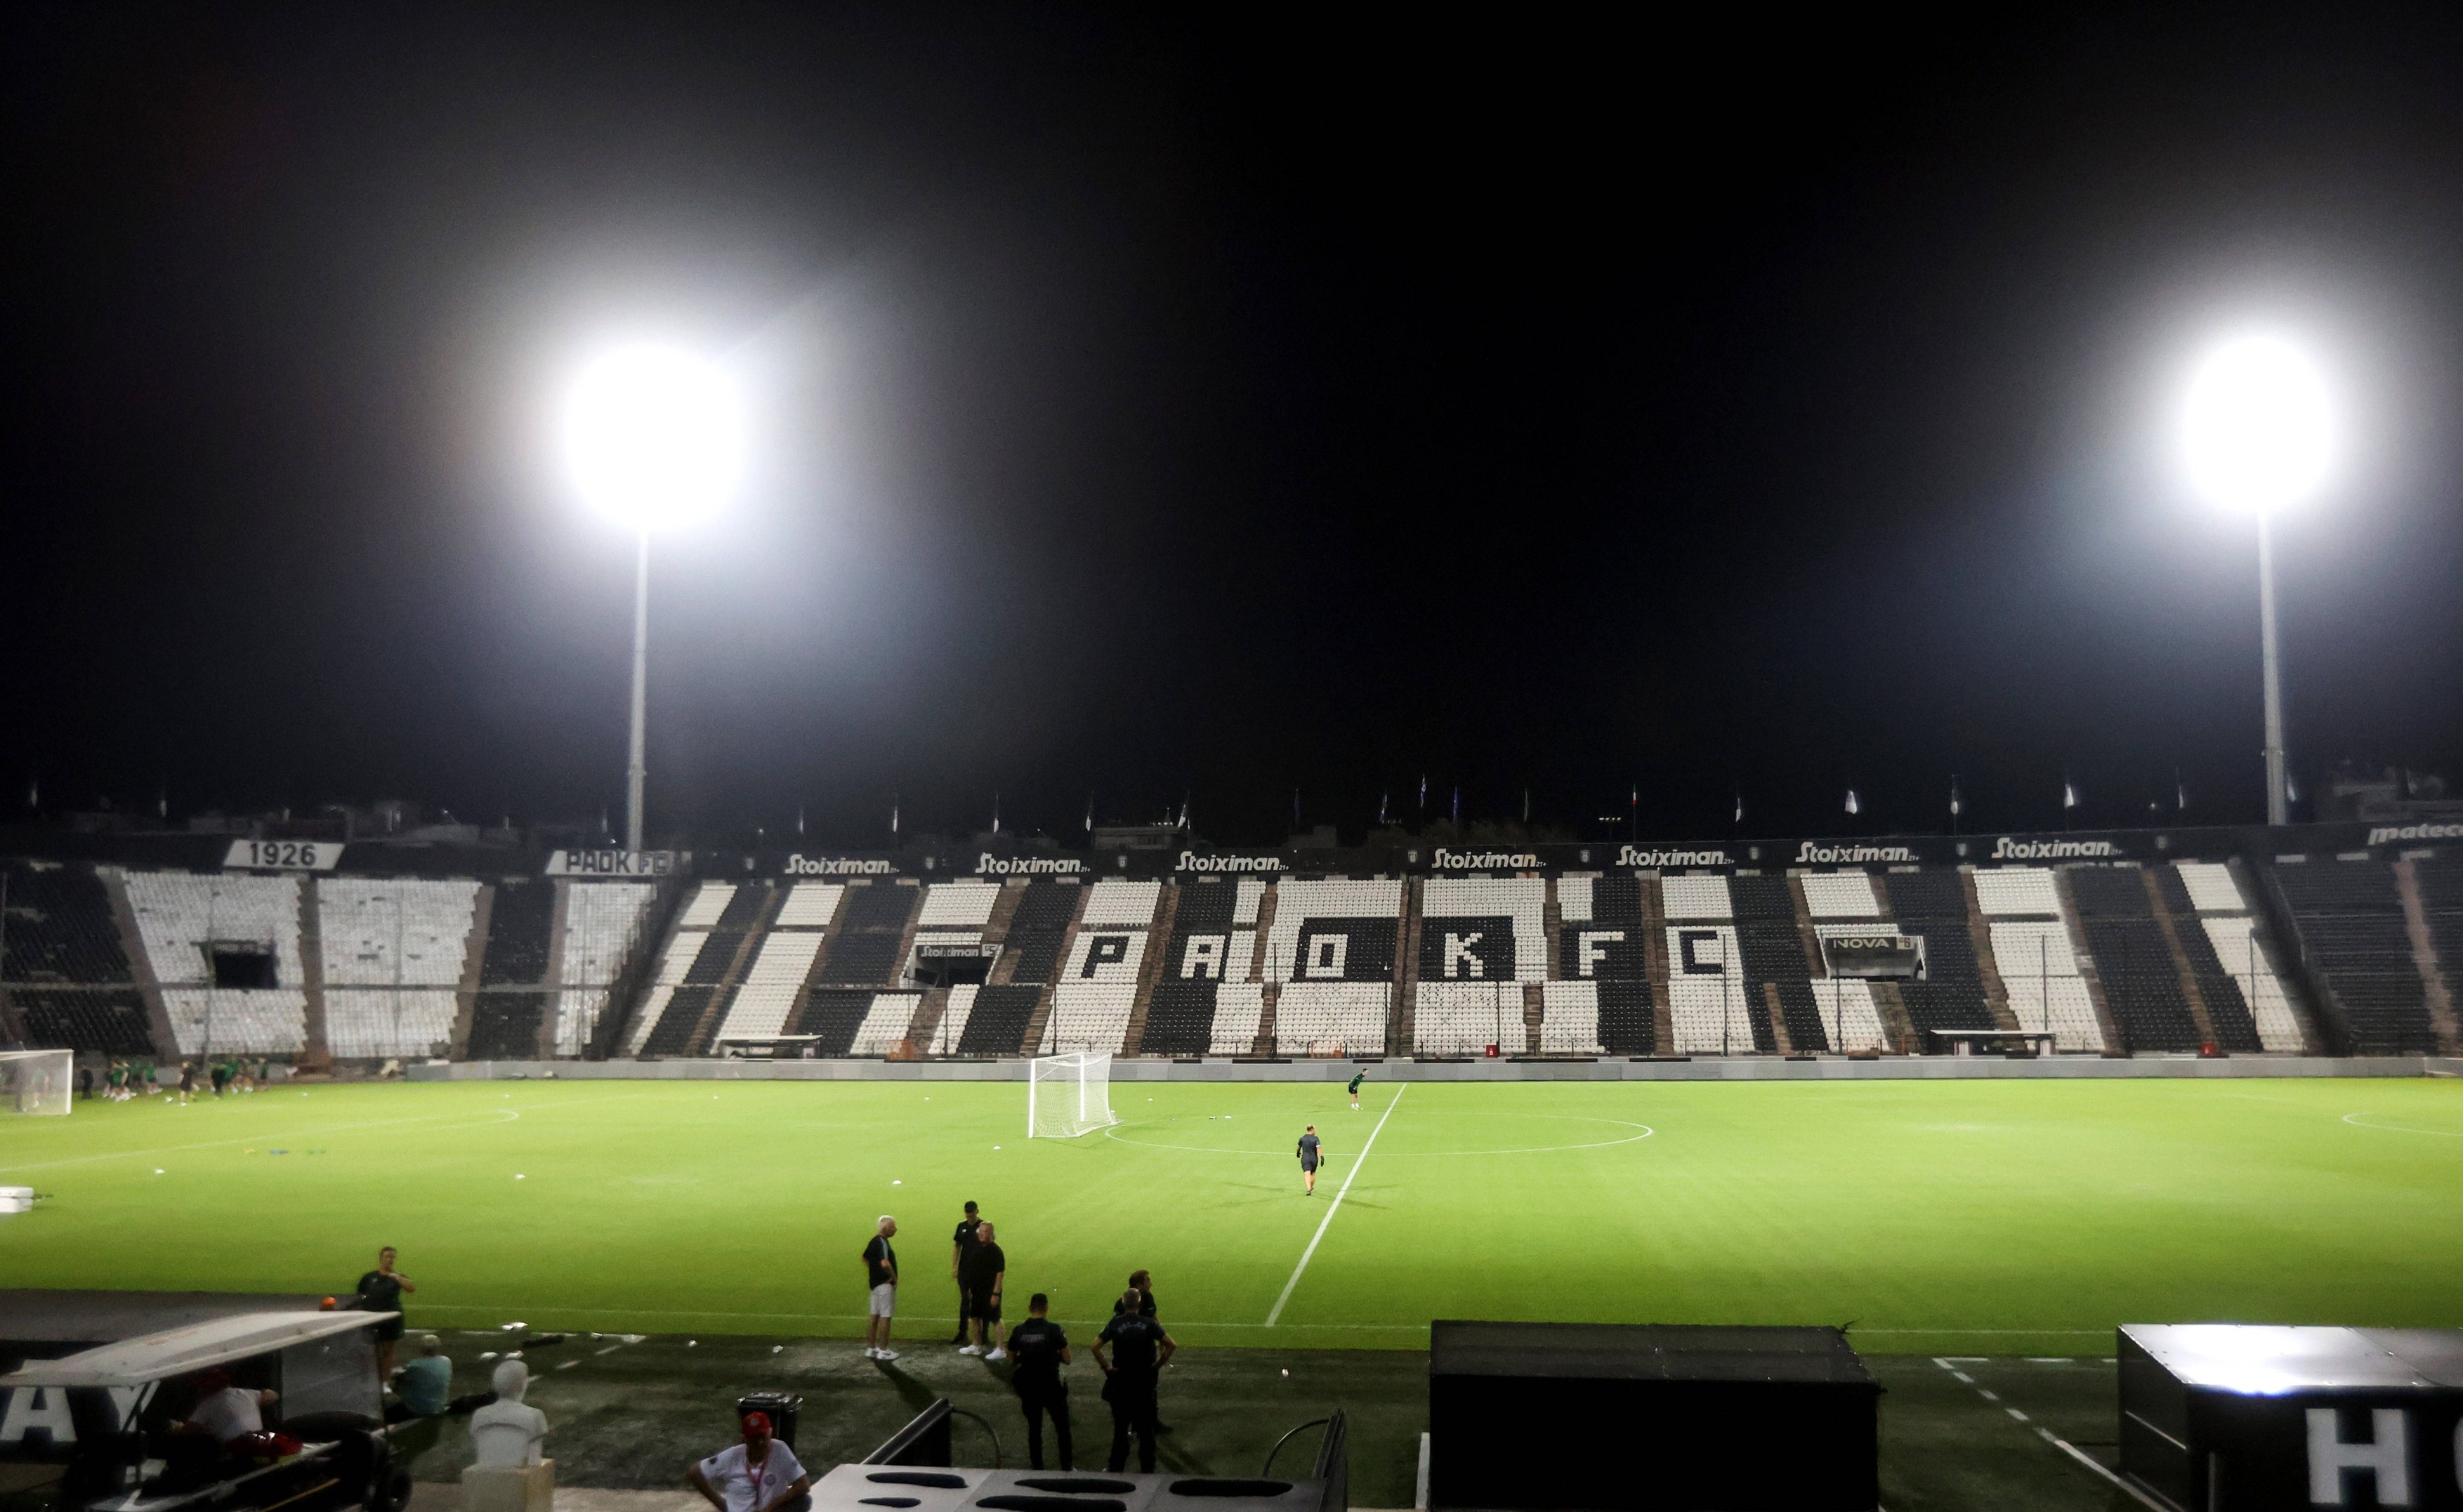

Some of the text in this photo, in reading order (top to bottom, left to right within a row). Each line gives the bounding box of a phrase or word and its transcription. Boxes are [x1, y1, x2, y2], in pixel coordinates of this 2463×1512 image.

[2367, 824, 2463, 845] matec
[250, 843, 315, 867] 1926
[1616, 845, 1724, 866] Stoiximan
[1795, 842, 1908, 862] Stoiximan
[1991, 837, 2110, 858] Stoiximan
[567, 850, 631, 872] PAOK
[784, 854, 890, 874] Stoiximan
[975, 852, 1081, 874] Stoiximan
[1175, 850, 1280, 871] Stoiximan
[1431, 848, 1537, 869] Stoiximan
[921, 945, 979, 957] Stoiximan
[1833, 938, 1889, 949] NOVA
[2306, 1407, 2463, 1505] H
